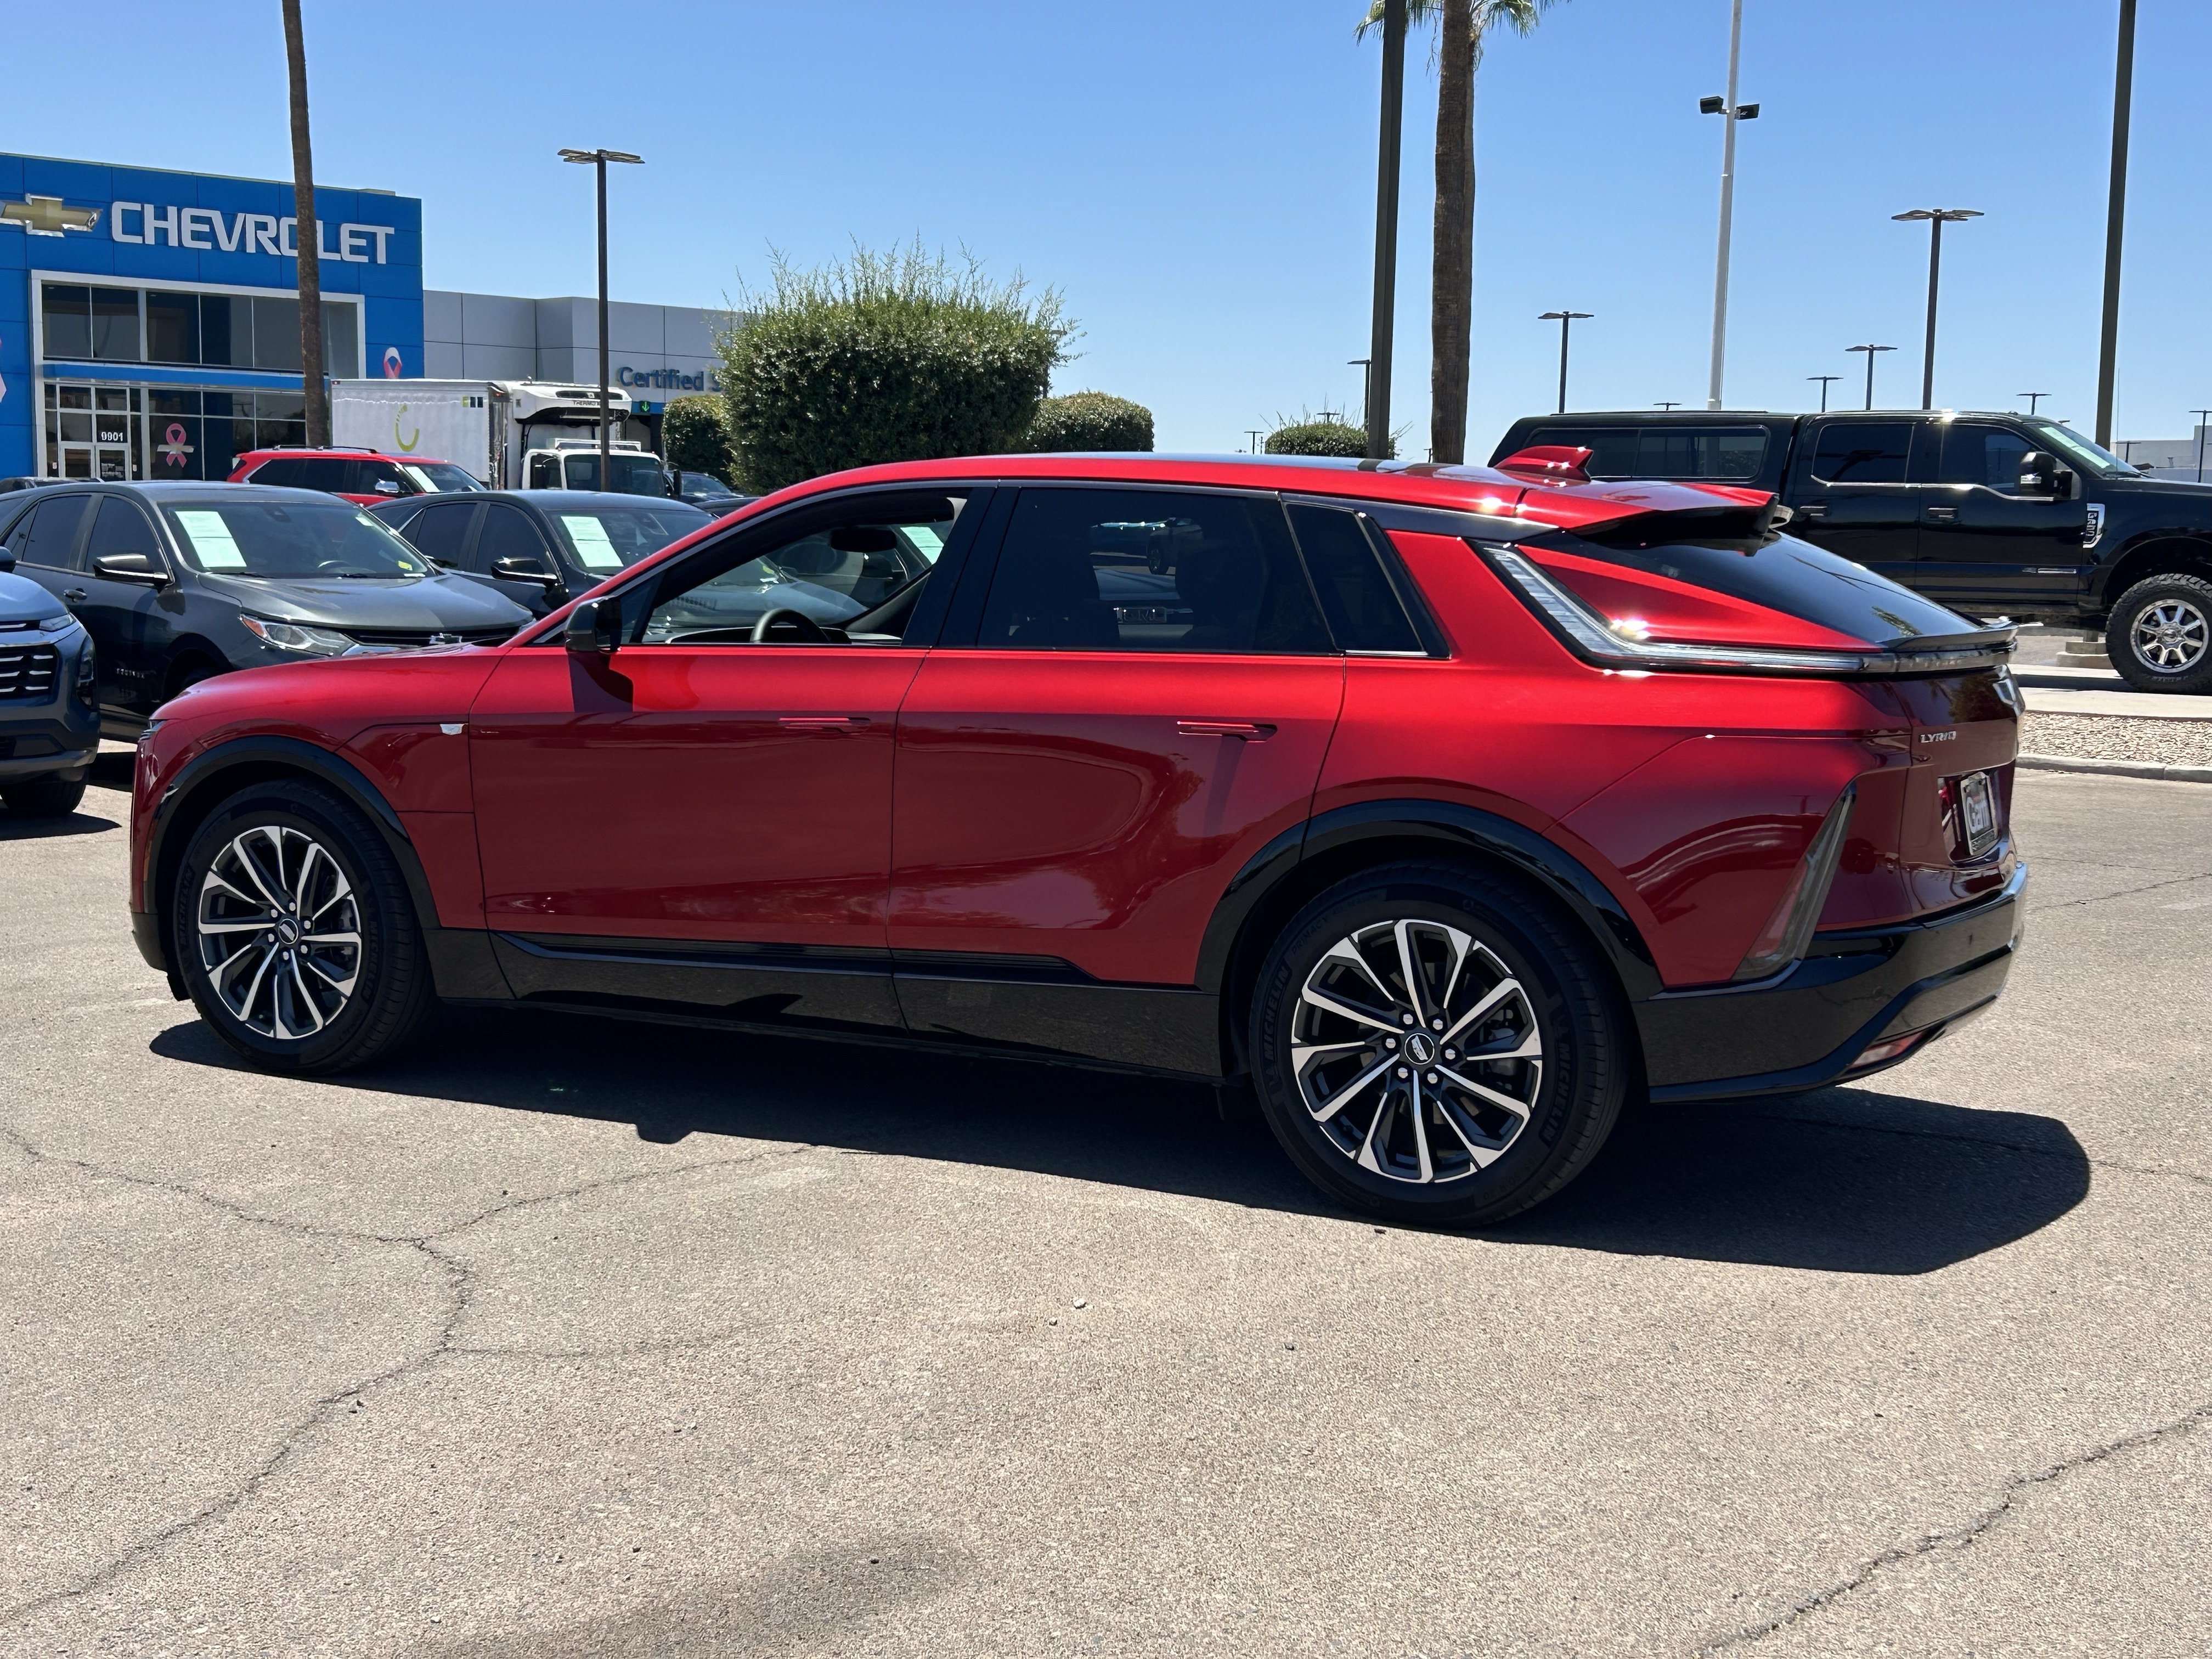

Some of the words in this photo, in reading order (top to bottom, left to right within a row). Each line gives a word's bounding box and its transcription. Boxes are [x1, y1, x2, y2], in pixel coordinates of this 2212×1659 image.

[112, 201, 394, 264] CHEVROLET
[617, 366, 704, 391] Certified
[1263, 966, 1290, 1062] MICHELIN
[1544, 1042, 1571, 1144] MICHELIN
